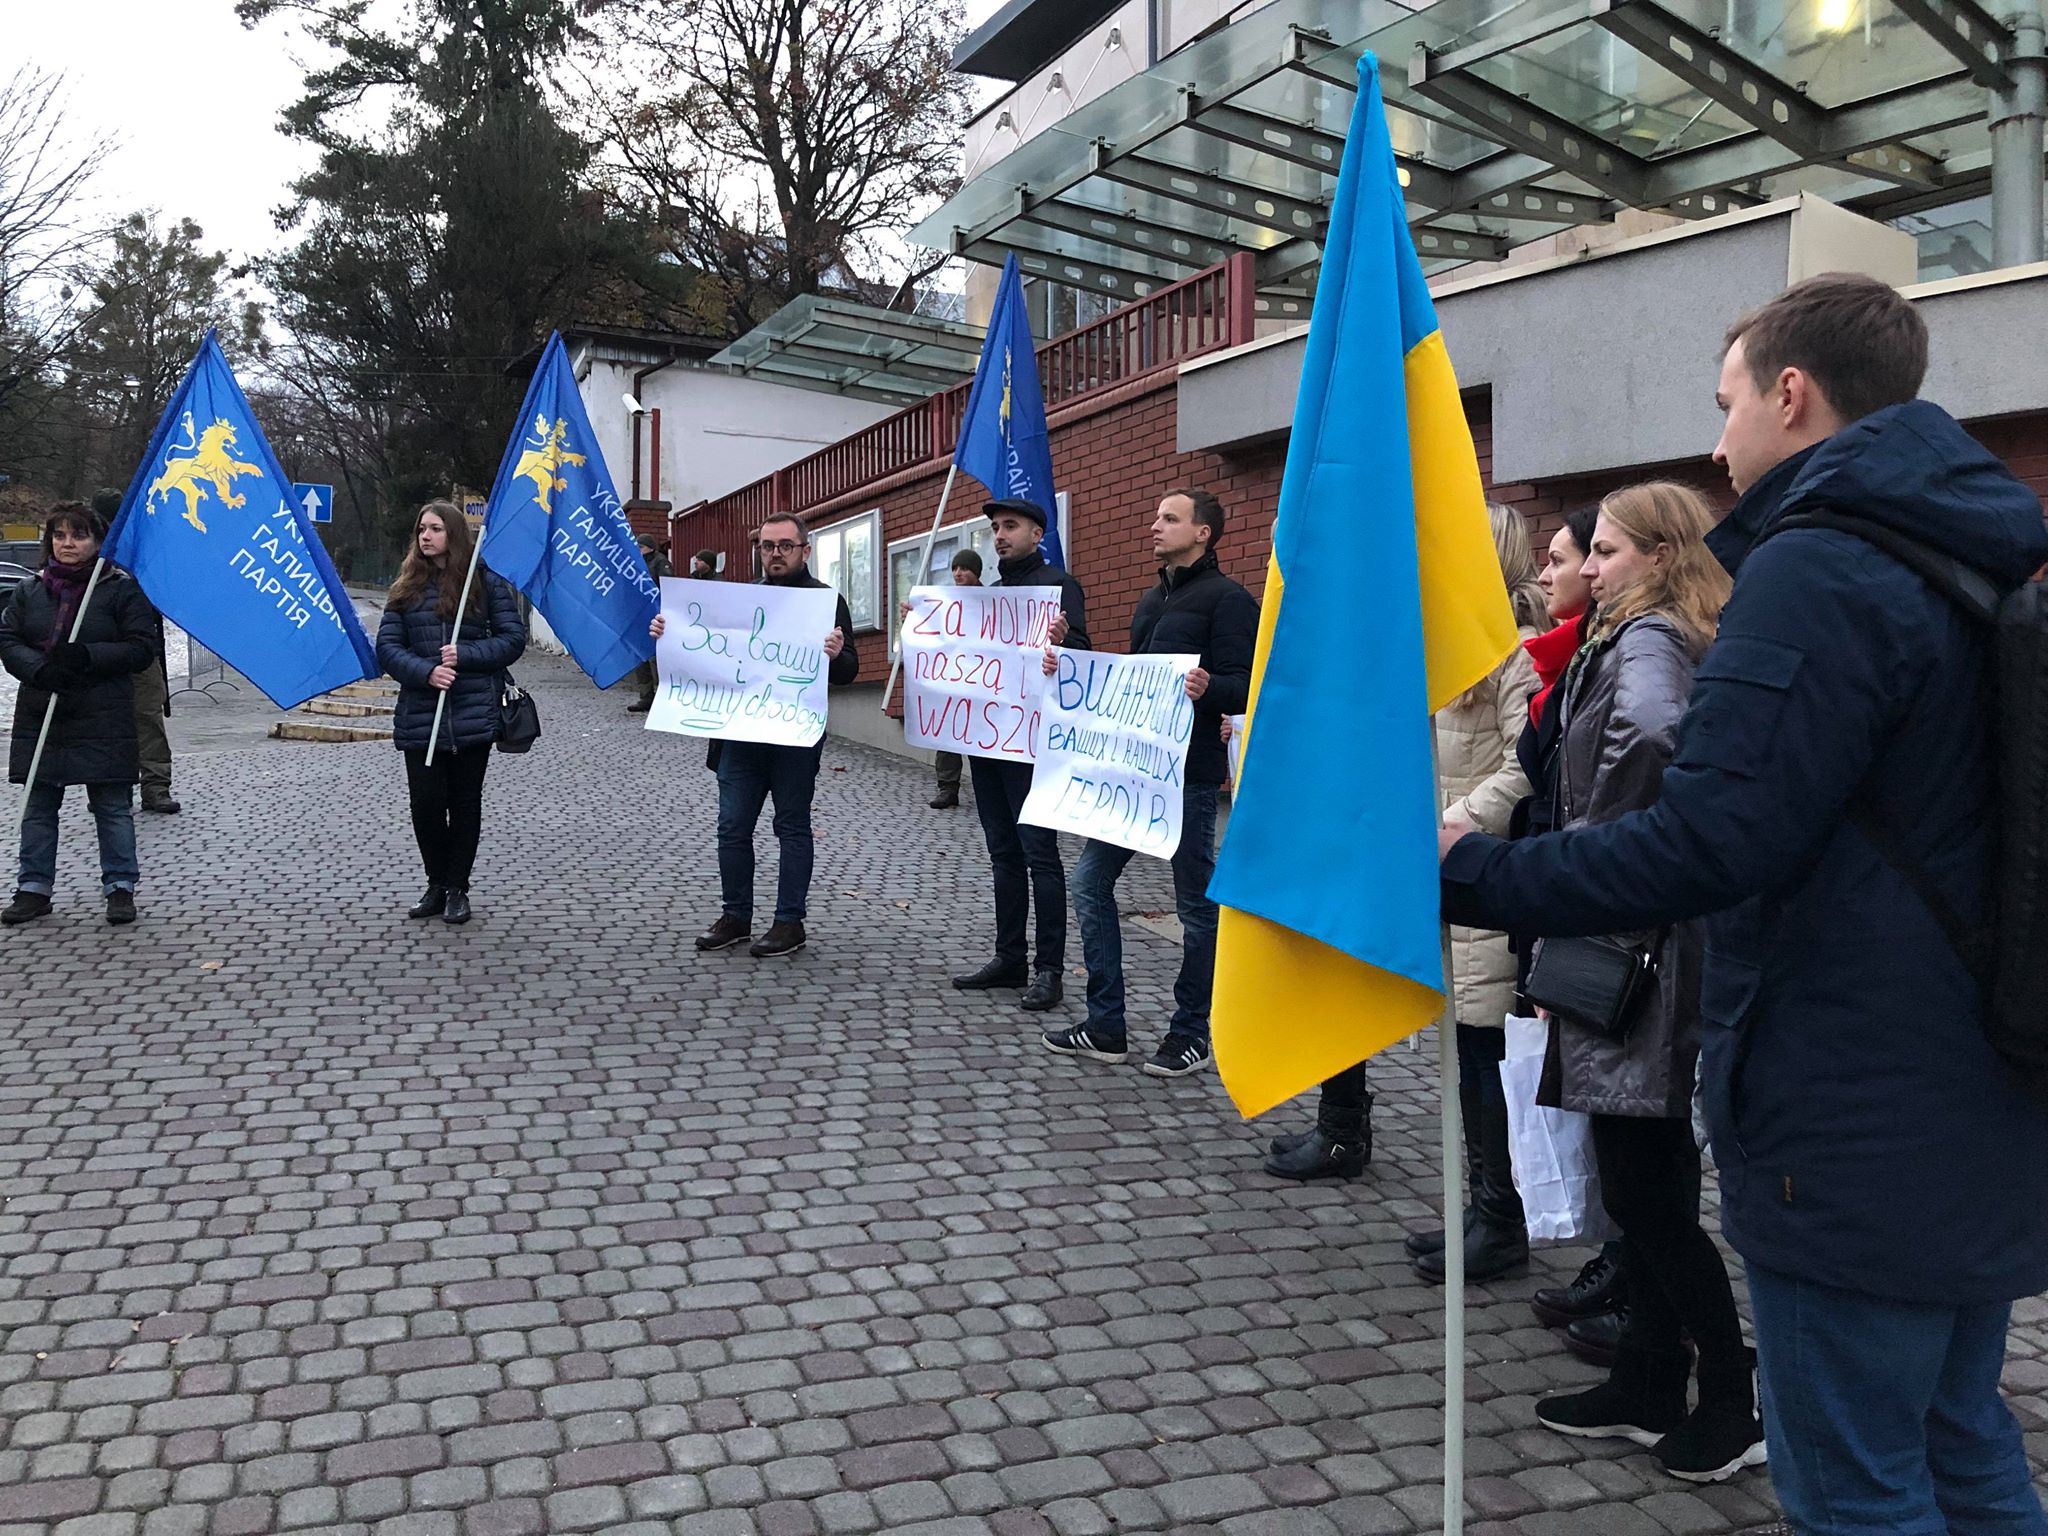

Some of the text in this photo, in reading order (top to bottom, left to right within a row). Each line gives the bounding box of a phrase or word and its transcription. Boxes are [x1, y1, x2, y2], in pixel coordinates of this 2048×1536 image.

[465, 502, 485, 516] ФОТО
[590, 482, 638, 546] УКРА
[251, 523, 346, 632] ГАЛИЦЬ
[569, 506, 660, 603] ГАЛИЦЬКА
[682, 602, 822, 684] За вашу
[915, 651, 1005, 696] naszą
[668, 673, 828, 741] нашу свободу
[1048, 723, 1109, 761] ВАШИХ
[1123, 738, 1180, 787] НАШИХ
[1053, 775, 1169, 849] ГЕРОЇВ
